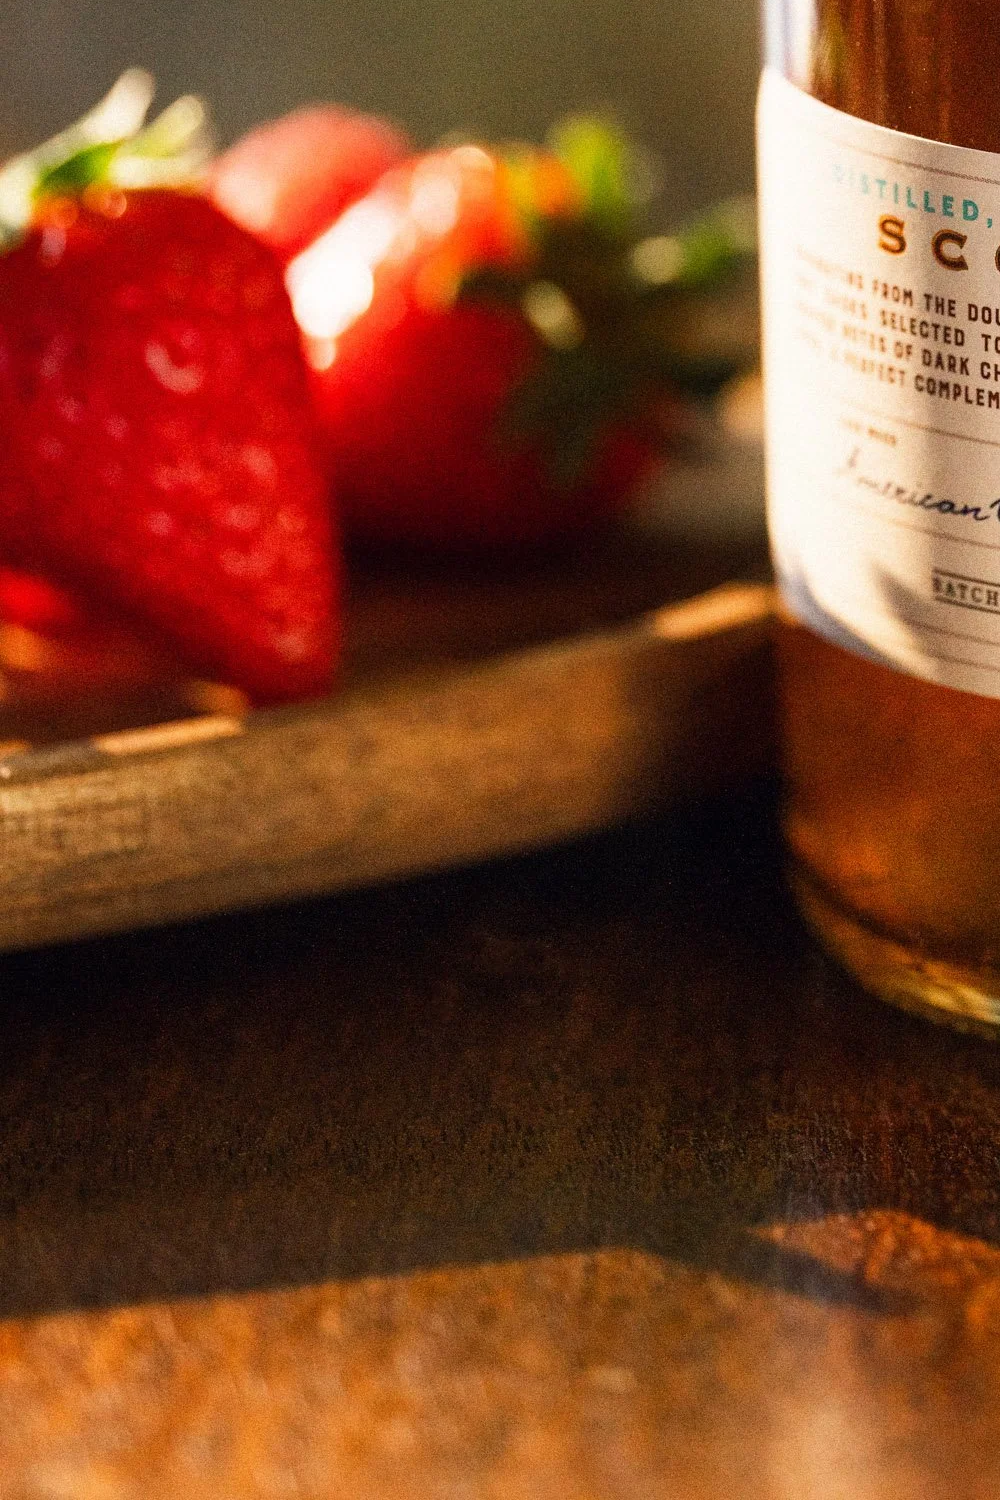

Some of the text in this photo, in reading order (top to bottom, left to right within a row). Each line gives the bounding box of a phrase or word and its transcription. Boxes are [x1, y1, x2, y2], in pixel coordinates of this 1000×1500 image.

[923, 293, 957, 319] THE
[880, 309, 965, 347] SELECTED
[922, 348, 970, 377] DARK
